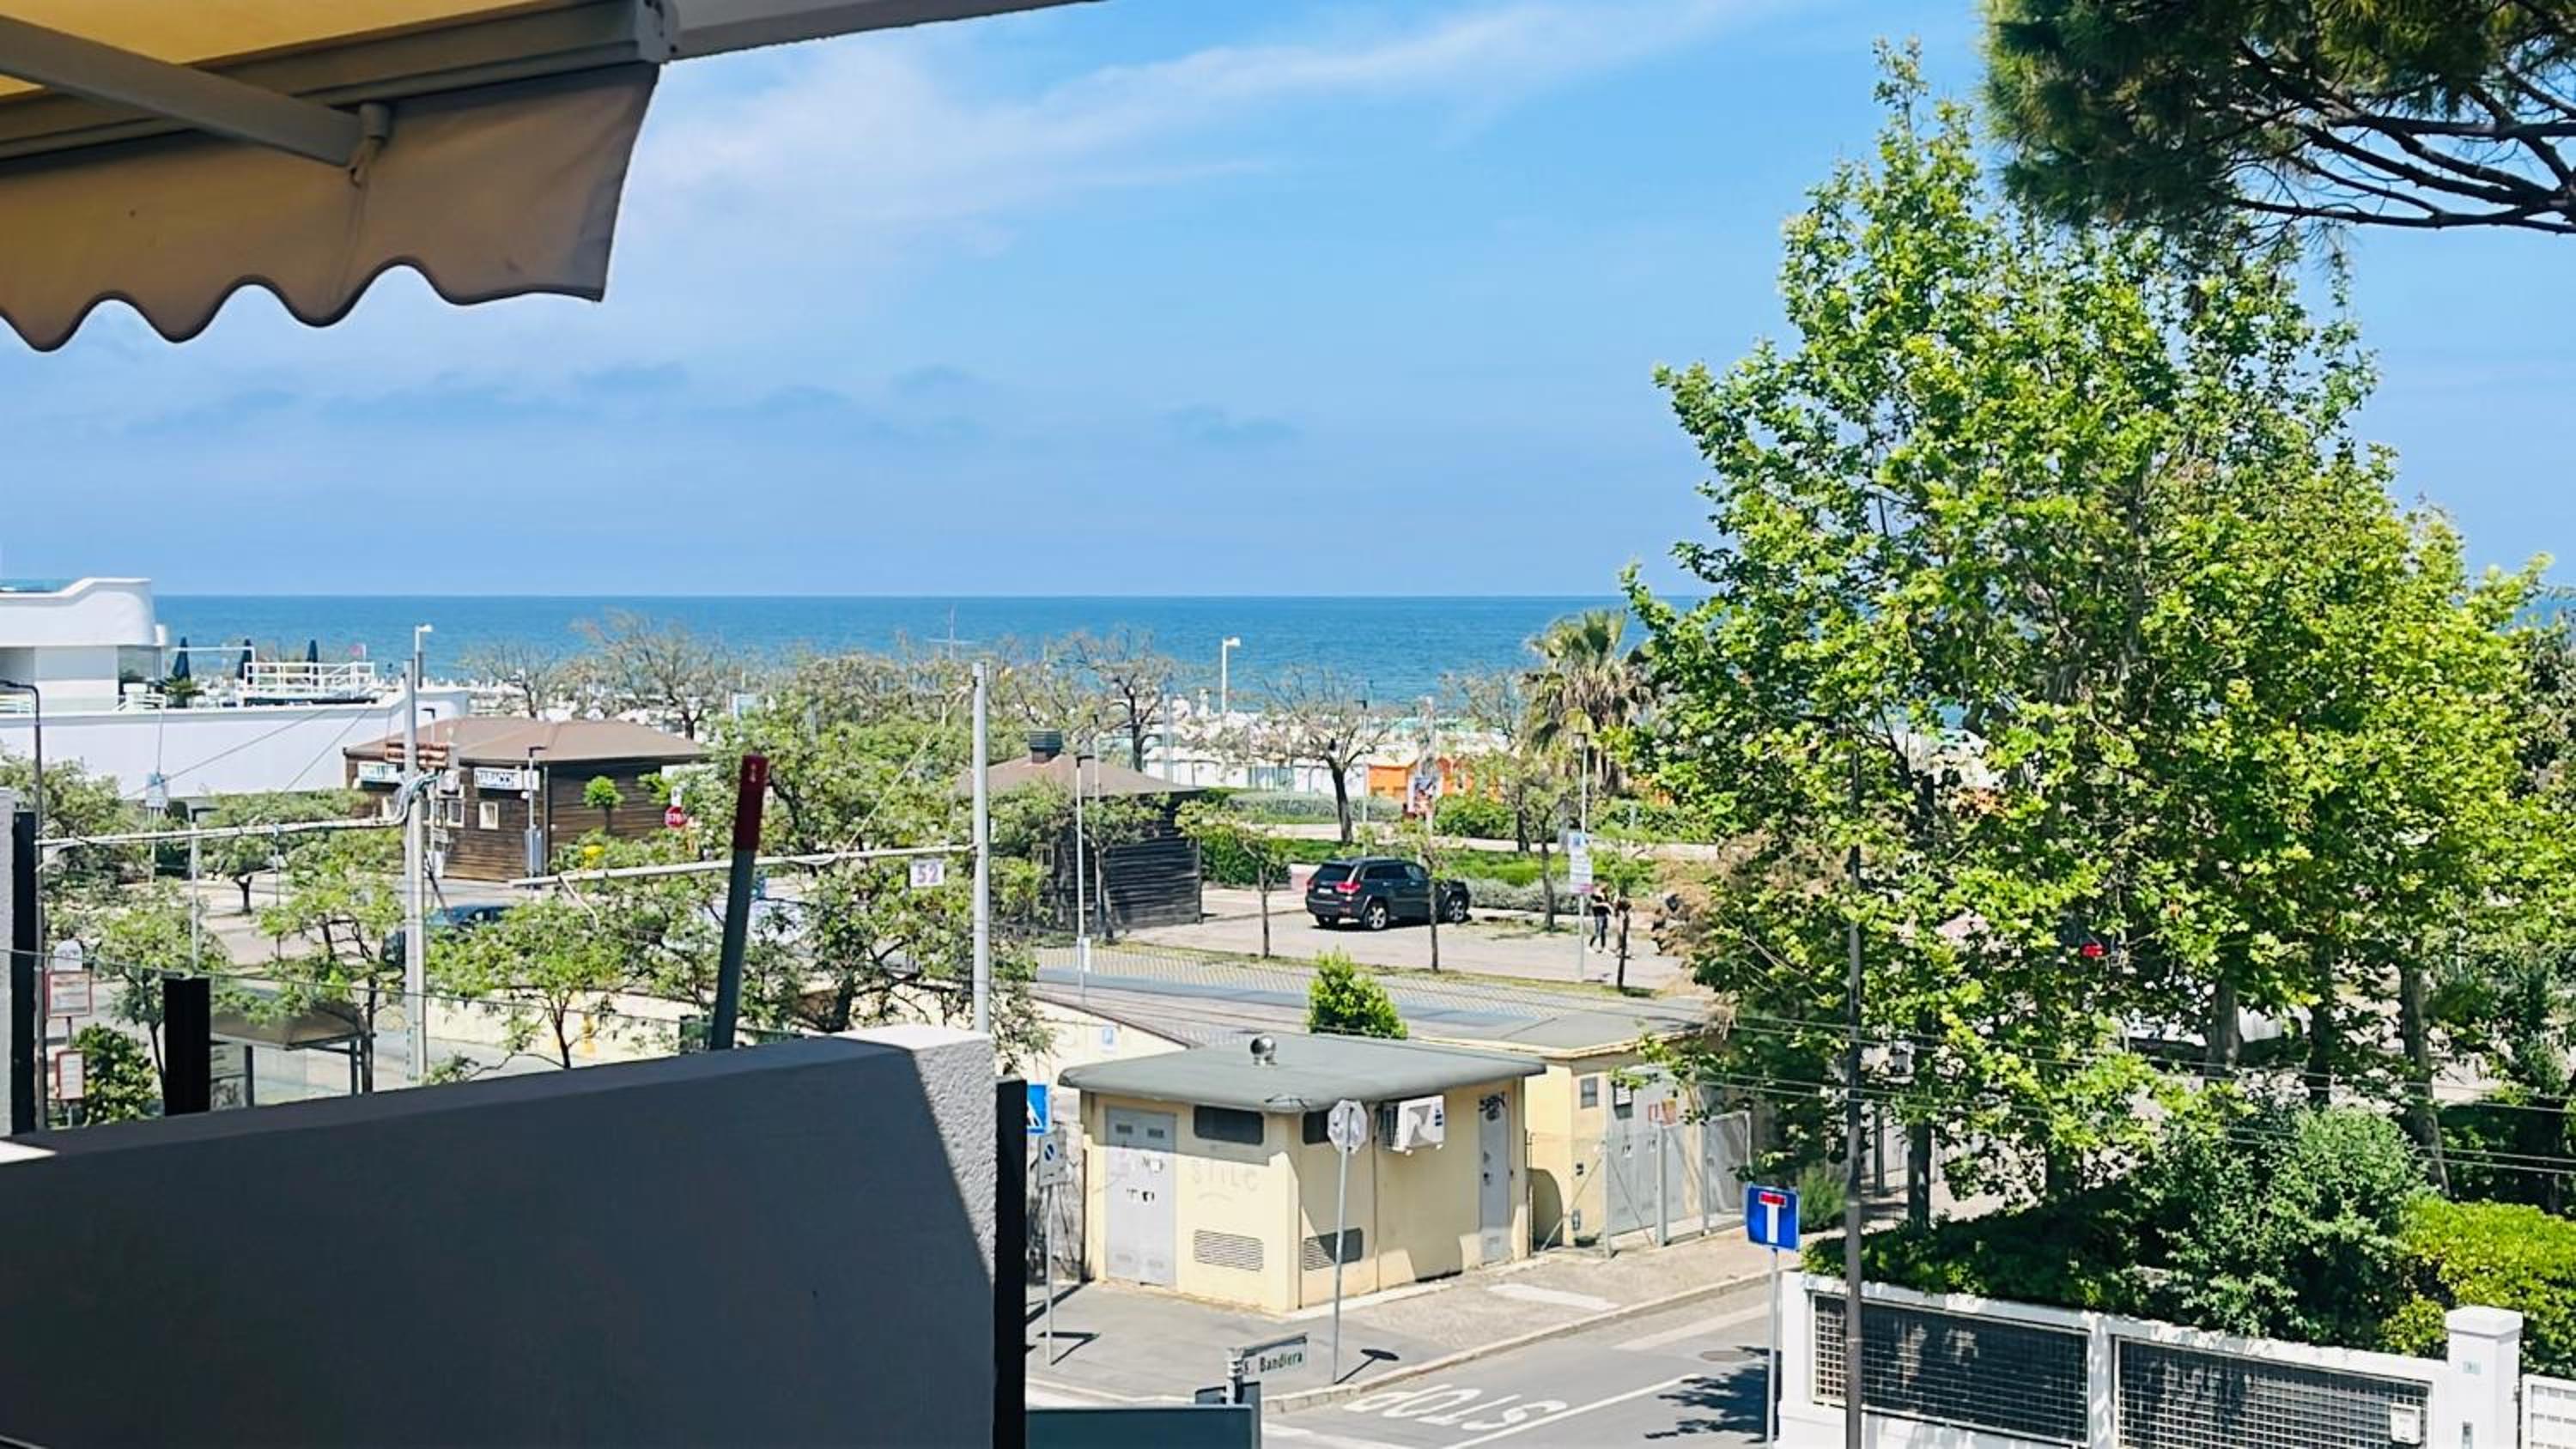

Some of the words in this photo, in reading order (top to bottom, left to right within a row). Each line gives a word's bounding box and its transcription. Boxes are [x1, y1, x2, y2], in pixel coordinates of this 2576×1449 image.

[917, 864, 939, 883] 52
[1260, 1352, 1303, 1373] Bandiera
[1342, 1383, 1568, 1431] STOP
